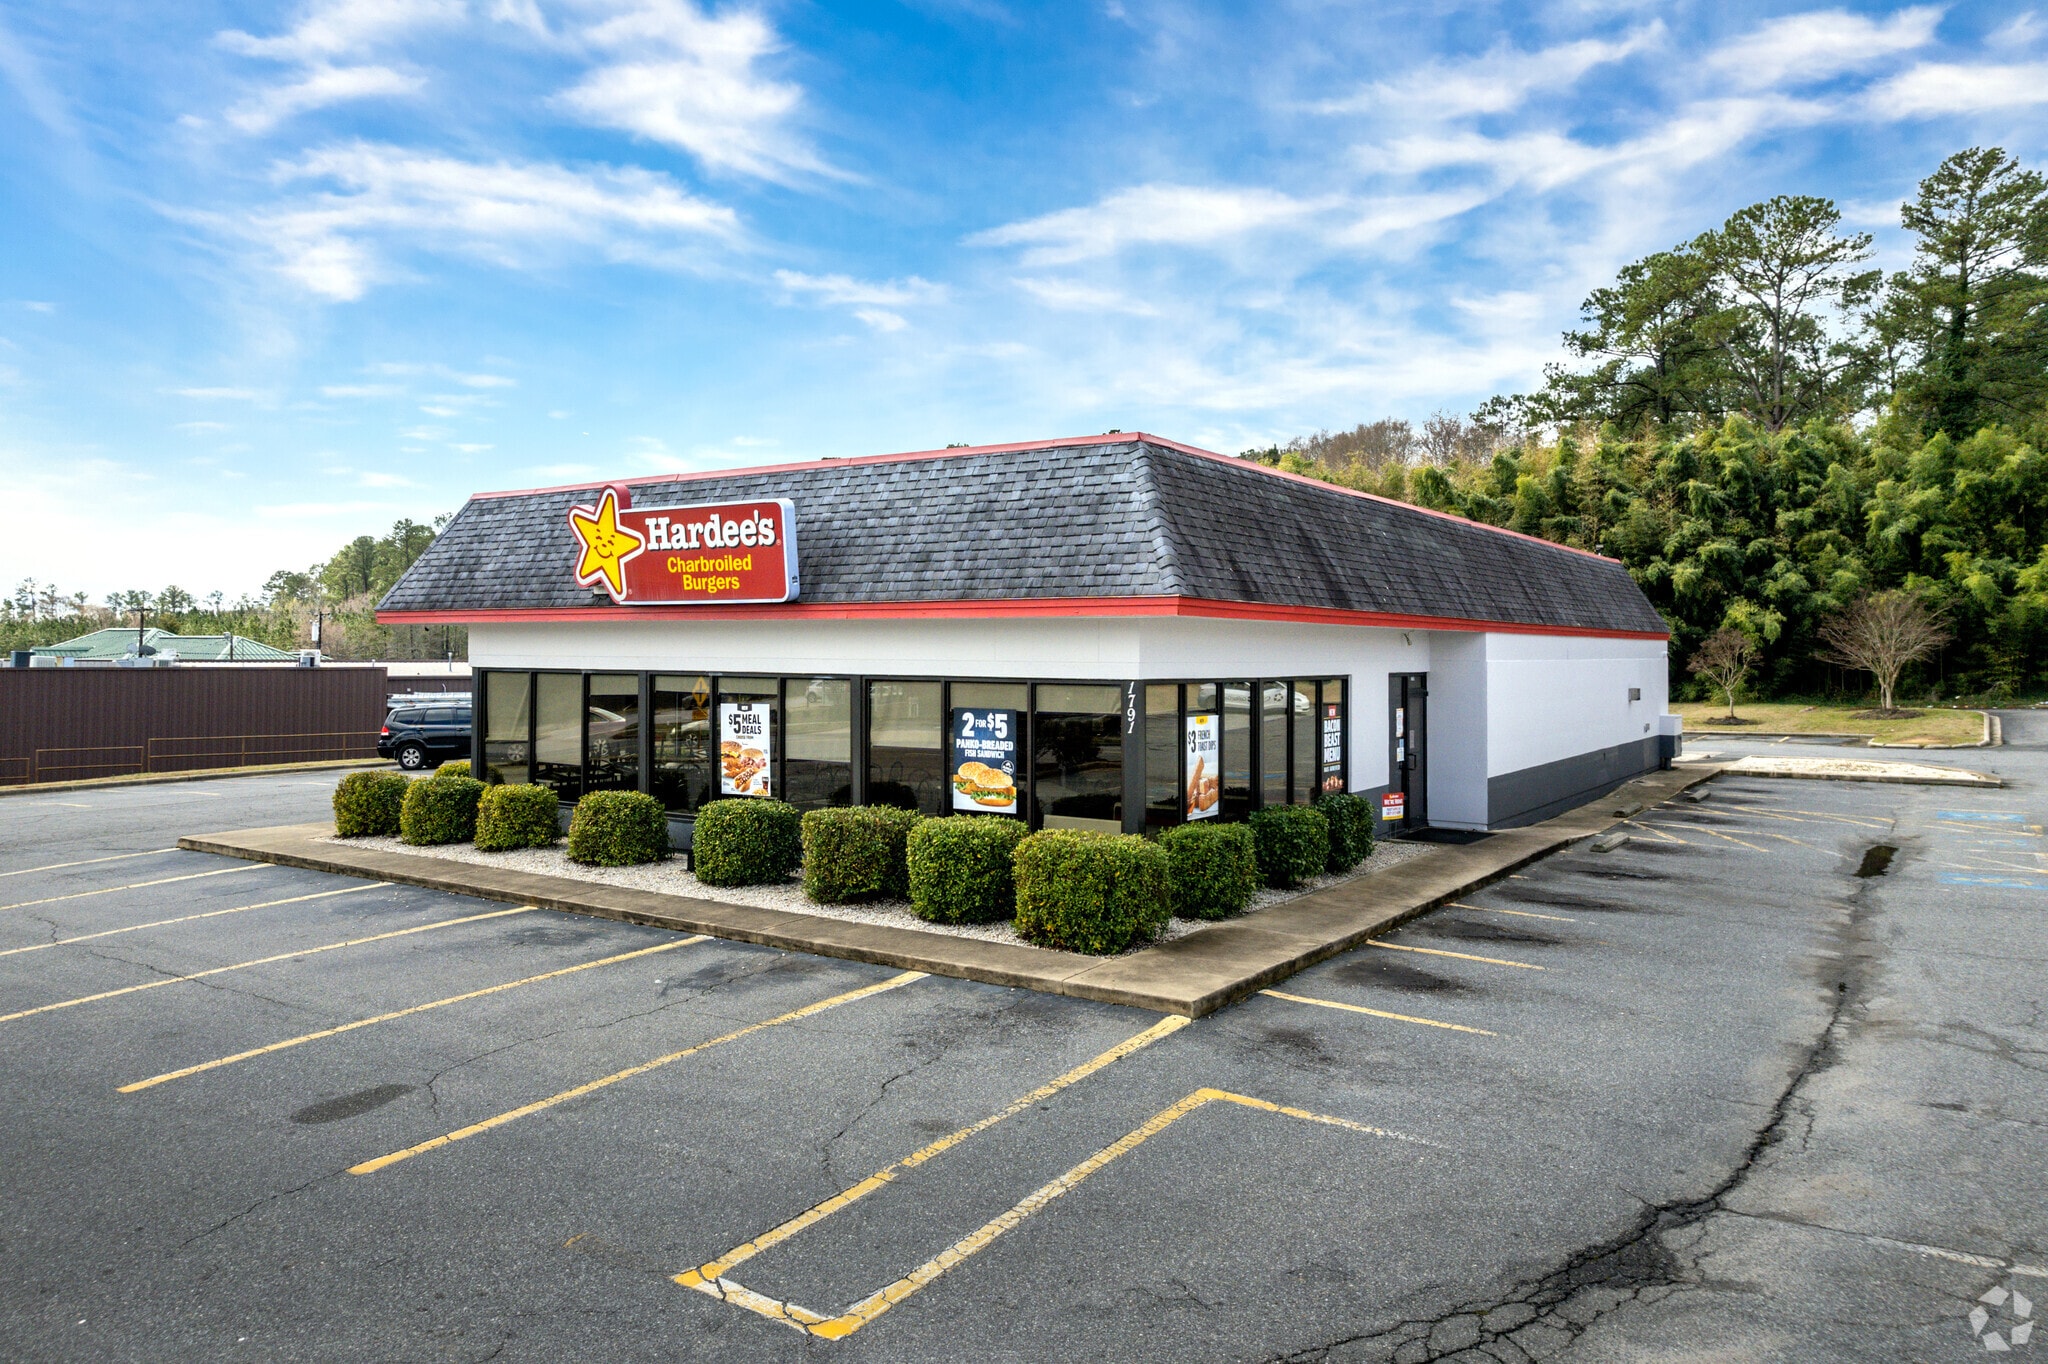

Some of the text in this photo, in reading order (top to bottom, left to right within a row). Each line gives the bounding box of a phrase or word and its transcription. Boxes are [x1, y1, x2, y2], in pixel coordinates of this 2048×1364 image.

[645, 509, 776, 551] Hardee's
[667, 554, 752, 573] Charbroiled
[683, 574, 740, 593] Burgers
[1127, 681, 1136, 734] 1791
[729, 713, 761, 734] $5 MEAL
[742, 725, 762, 734] DEALS
[962, 712, 1008, 738] 2 FOR $5
[956, 739, 1014, 751] PANKO-BREADED
[1188, 730, 1210, 753] $3 FRENCH
[1324, 732, 1341, 747] BEAST
[965, 749, 1005, 759] FISH SANDWICH
